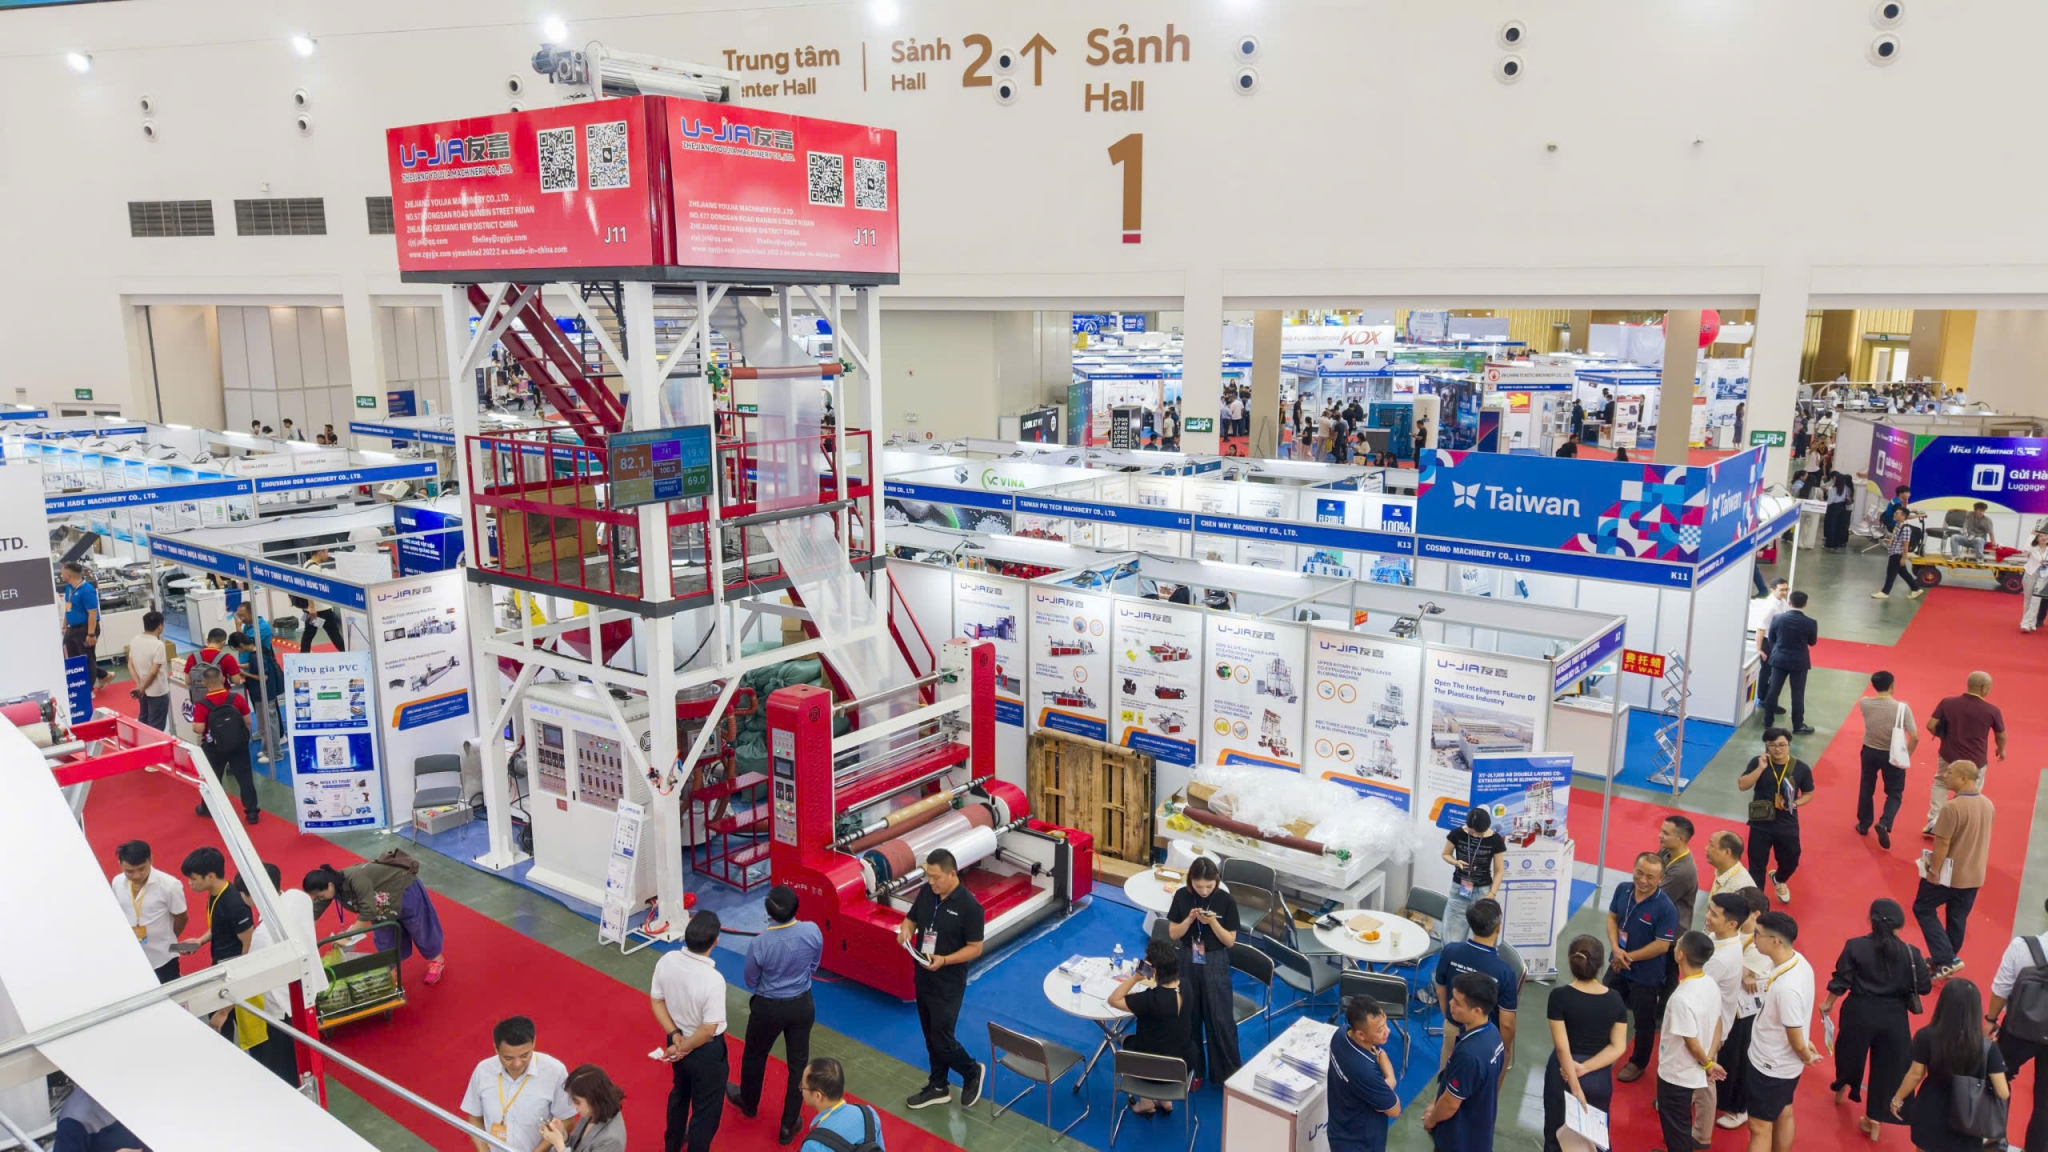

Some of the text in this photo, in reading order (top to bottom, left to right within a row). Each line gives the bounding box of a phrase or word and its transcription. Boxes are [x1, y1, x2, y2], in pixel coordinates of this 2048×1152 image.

[1085, 23, 1191, 67] Sảnh
[723, 45, 841, 76] Trung tâm
[891, 33, 993, 88] Sảnh 2
[784, 76, 817, 98] Hall
[892, 72, 926, 92] Hall
[1084, 81, 1144, 112] Hall
[682, 141, 772, 159] ZHEJIANG YOUJIA MACHINERY
[402, 166, 486, 184] ZHEJIANG YOUJIA MACHINERY
[1107, 132, 1143, 231] 1
[430, 197, 451, 207] YOUJIA
[688, 200, 772, 214] ZHEJIANG YOUJIA MACHINERY
[453, 205, 535, 218] ROAD NANBIN STREET RUIAN
[460, 222, 473, 231] NEW
[473, 221, 498, 230] DISTRICT
[499, 220, 518, 229] CHINA
[604, 226, 628, 244] J11
[853, 227, 877, 247] J11
[1339, 330, 1382, 346] KDX
[620, 456, 645, 470] 82.1
[660, 466, 676, 474] 100.3
[688, 475, 705, 486] 69.0
[2010, 469, 2030, 479] Gửi
[261, 479, 291, 488] ZHOUSHAN
[305, 475, 338, 484] MACHINERY
[1001, 478, 1025, 488] VINA
[2008, 482, 2045, 491] Luggage
[67, 499, 85, 508] JIADE
[87, 495, 126, 506] MACHINERY
[1485, 486, 1580, 518] Taiwan
[1063, 505, 1092, 514] MACHINERY
[1233, 523, 1268, 533] MACHINERY
[1270, 528, 1282, 536] CO.,
[0, 537, 28, 551] TD.
[1425, 543, 1531, 562] COSMO MACHINERY CO., LTD
[1670, 571, 1688, 581] K11
[355, 593, 364, 602] J14
[298, 666, 316, 675] Phụ
[319, 666, 335, 674] gia
[1638, 667, 1661, 675] WAX
[1434, 678, 1451, 687] Open
[1466, 684, 1500, 696] Intelligent
[1502, 690, 1526, 700] Future
[1448, 689, 1474, 700] Plastics
[1476, 694, 1505, 706] Industry
